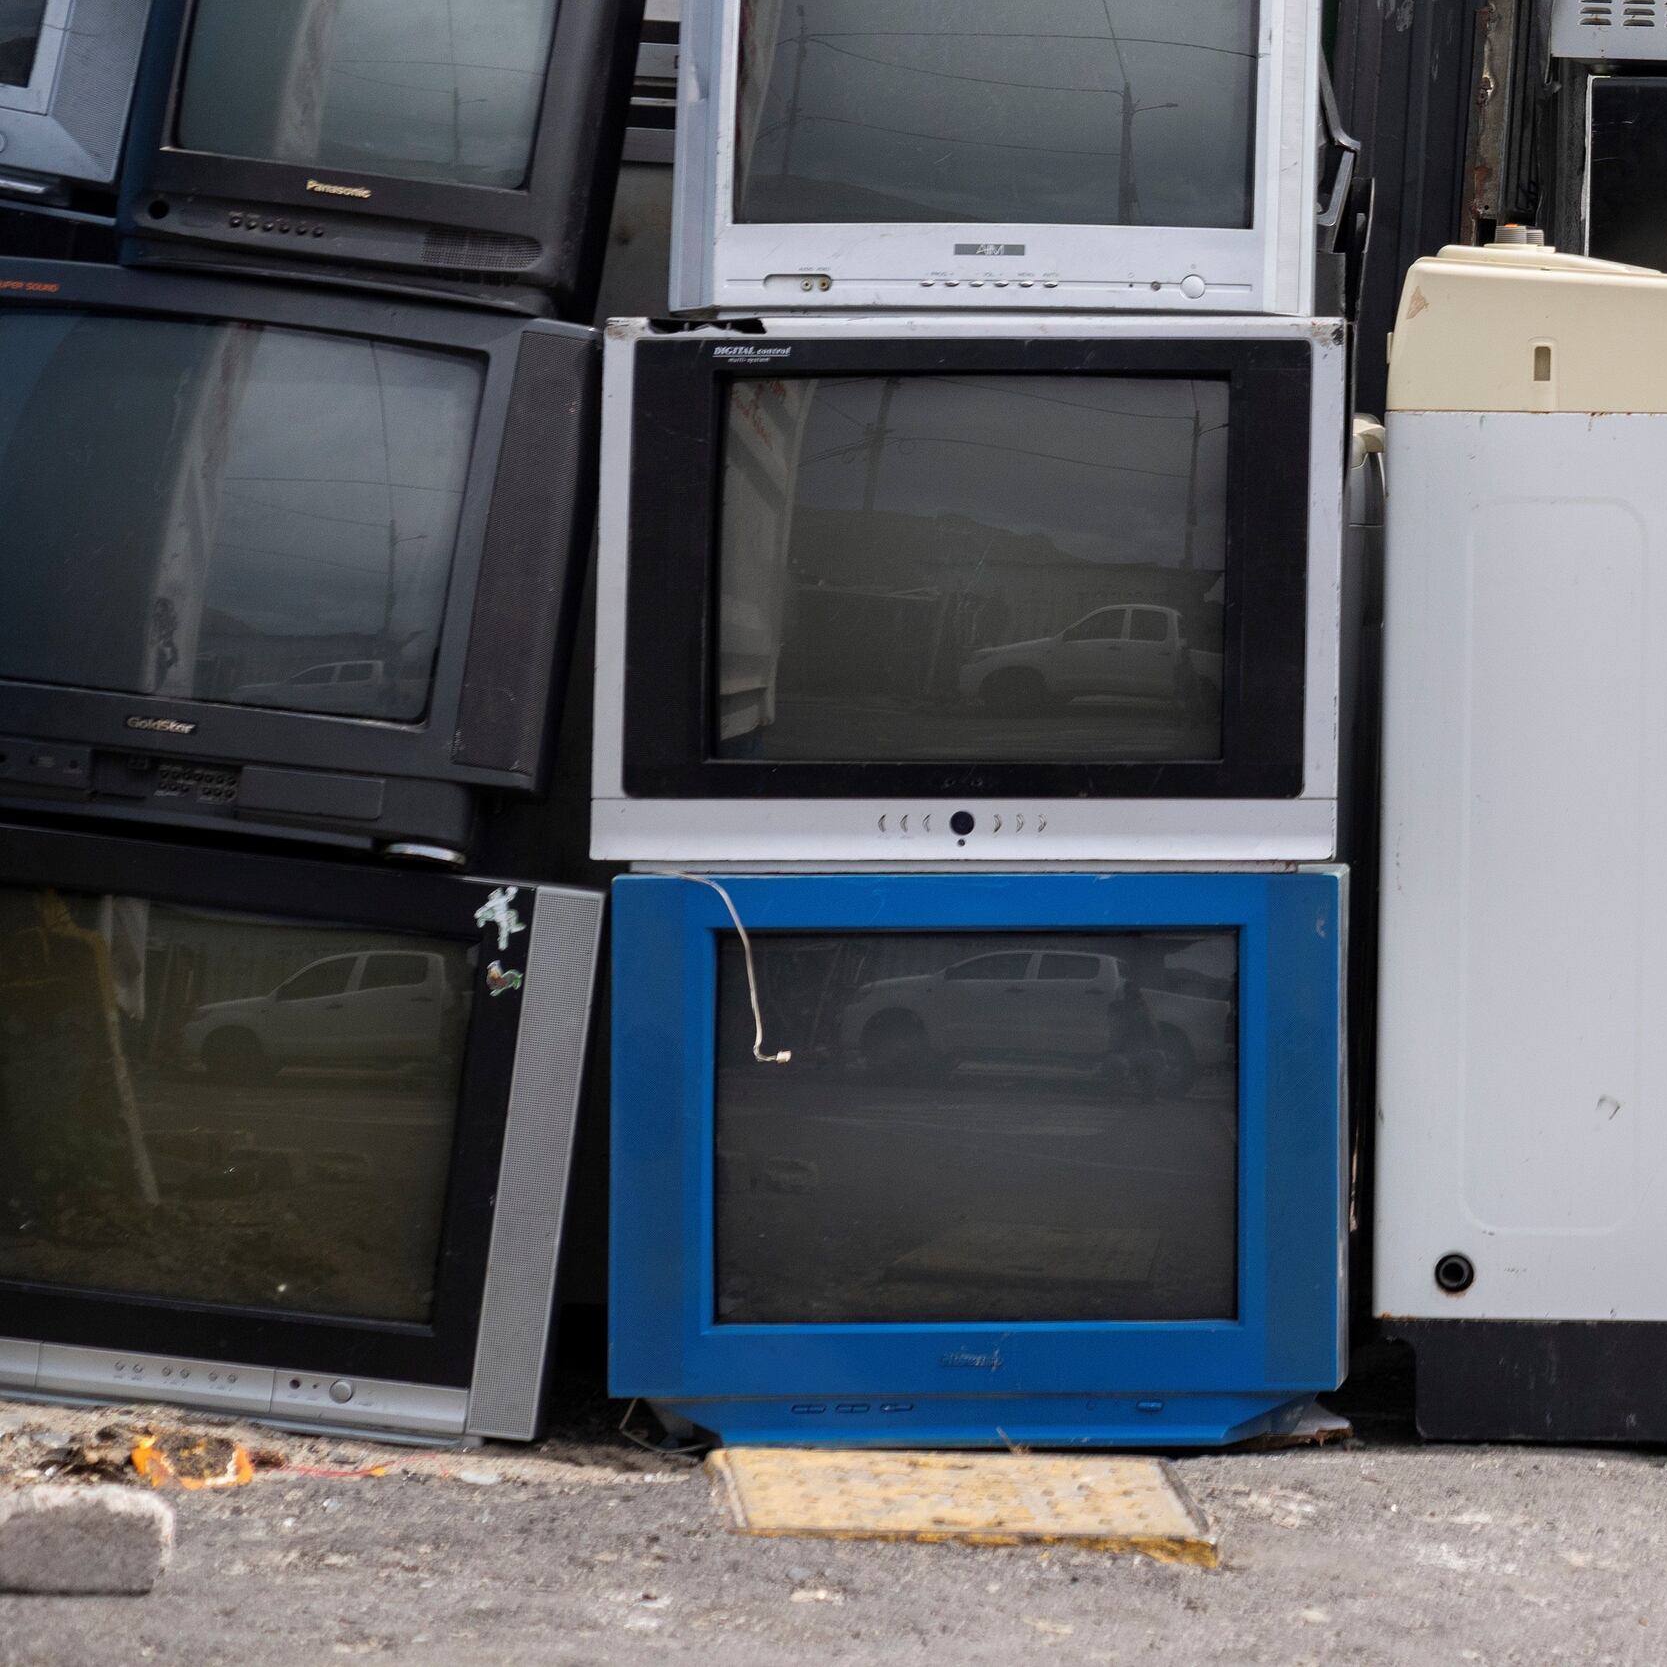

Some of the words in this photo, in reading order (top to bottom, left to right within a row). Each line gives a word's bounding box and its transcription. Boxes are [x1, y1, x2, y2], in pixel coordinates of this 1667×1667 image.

[306, 178, 372, 199] Panasonic
[713, 346, 755, 355] DIGITAL
[127, 717, 196, 734] GoldStar
